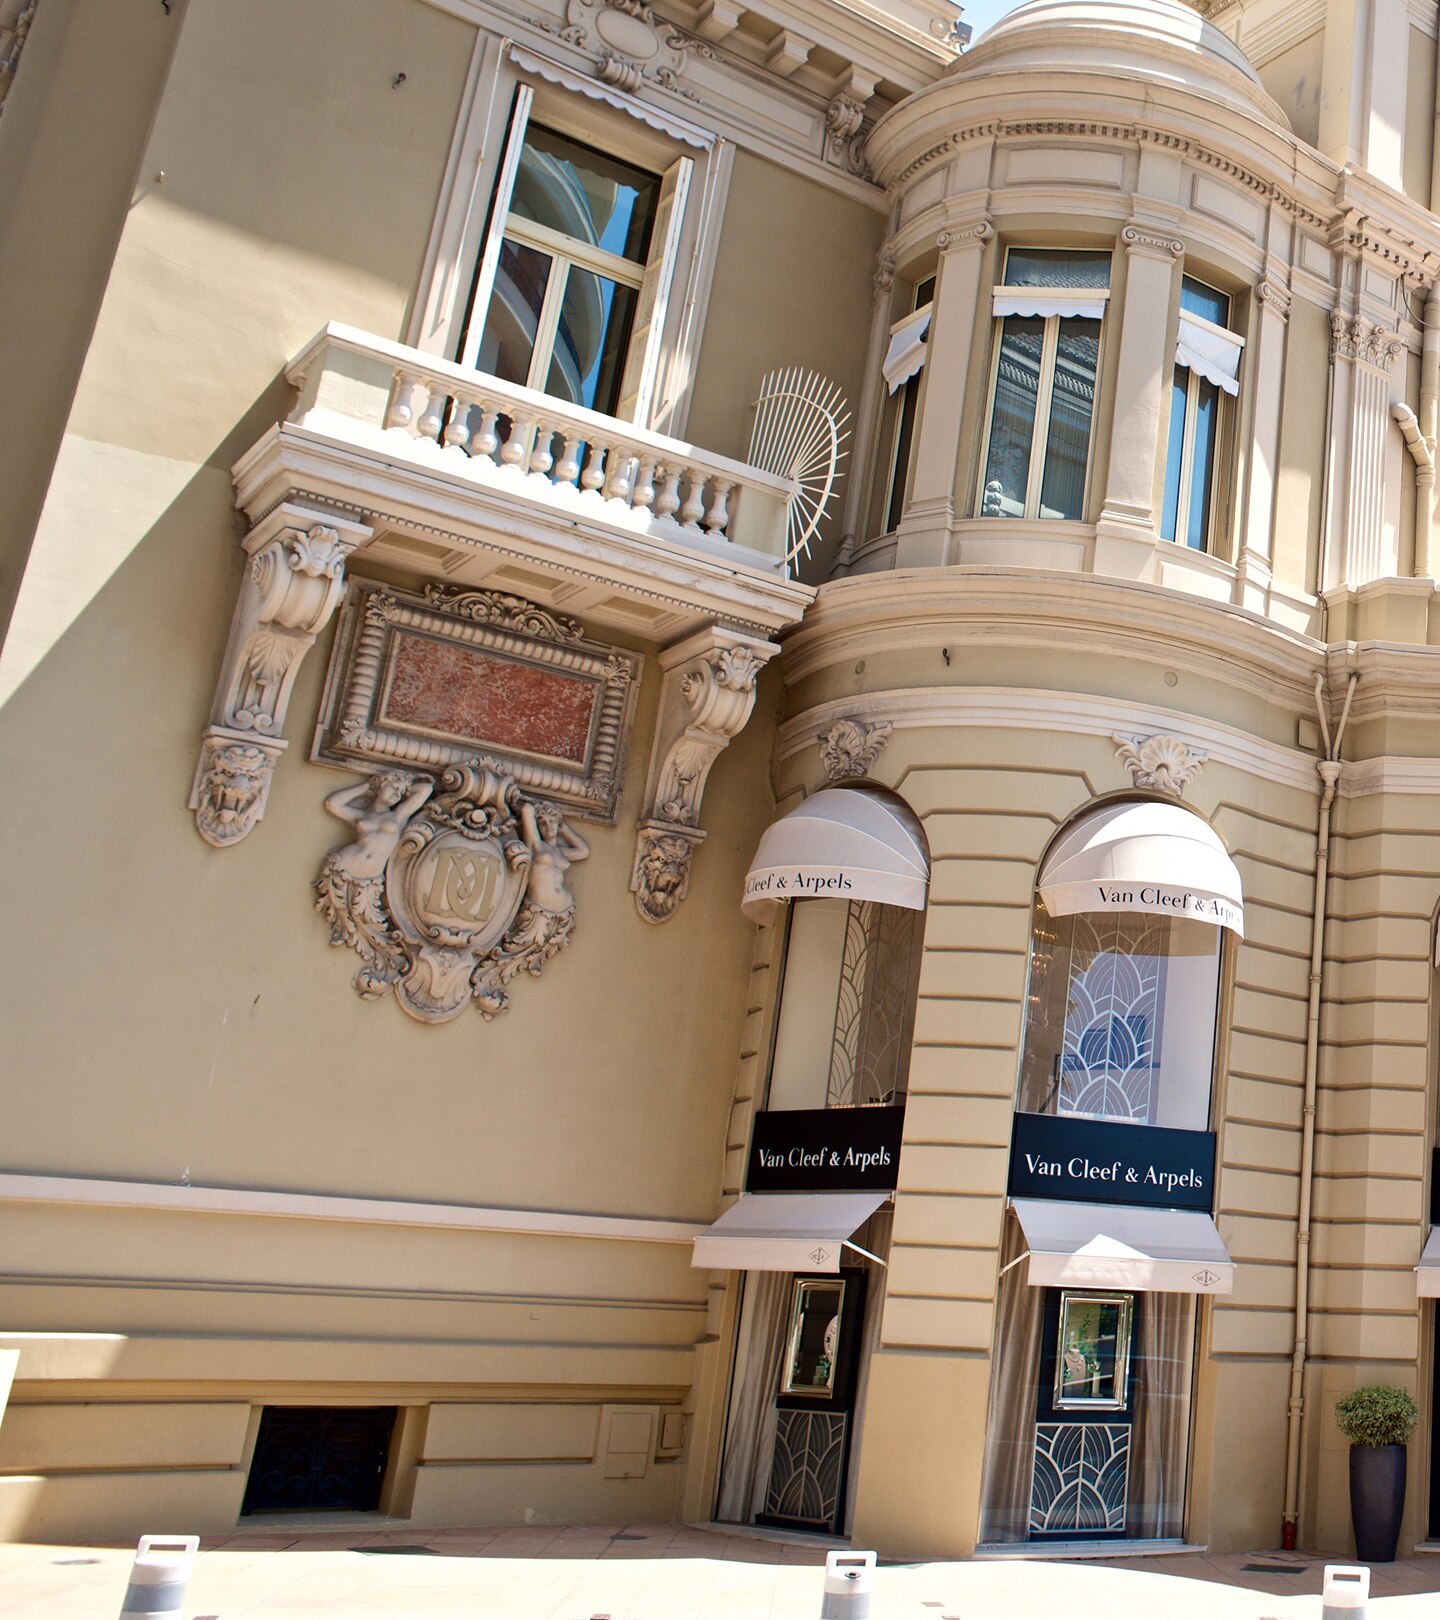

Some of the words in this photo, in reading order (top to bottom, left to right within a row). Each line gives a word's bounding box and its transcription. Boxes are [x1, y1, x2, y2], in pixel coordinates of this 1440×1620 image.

[776, 875, 788, 889] &
[792, 872, 852, 893] Arpels
[1098, 887, 1133, 903] Van
[1140, 887, 1191, 909] Cleef
[759, 1149, 784, 1167] Van
[788, 1147, 828, 1167] Cleef
[829, 1151, 840, 1167] &
[843, 1146, 891, 1172] Arpels
[1025, 1153, 1062, 1176] Van
[1067, 1157, 1122, 1181] Cleef
[1125, 1167, 1139, 1183] &
[1143, 1165, 1203, 1192] Arpels
